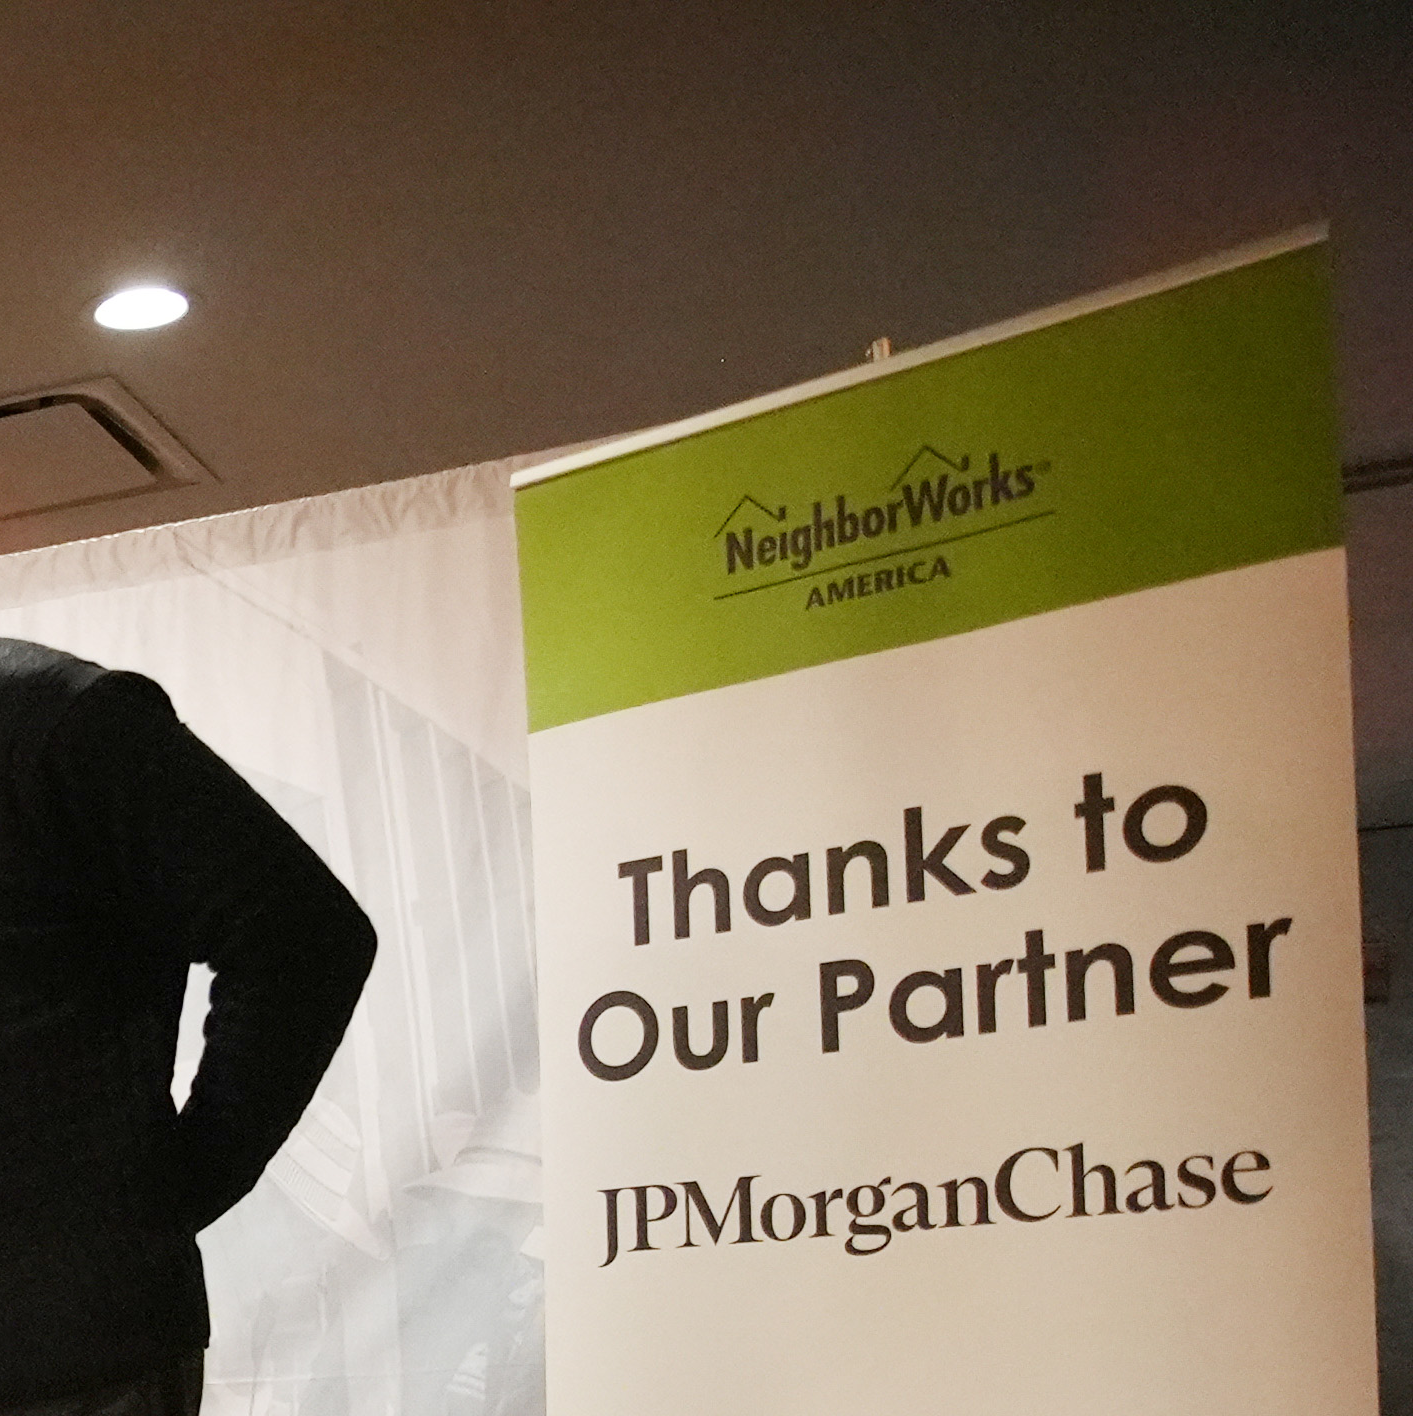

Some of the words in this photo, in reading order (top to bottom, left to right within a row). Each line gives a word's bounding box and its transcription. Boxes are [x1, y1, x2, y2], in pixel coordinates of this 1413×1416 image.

[805, 556, 952, 610] AMERICA
[619, 806, 1031, 946] Thanks
[1073, 771, 1209, 874] to
[578, 990, 775, 1082] Our
[819, 915, 1295, 1054] Partner
[598, 1142, 1274, 1268] JPMorganChase
